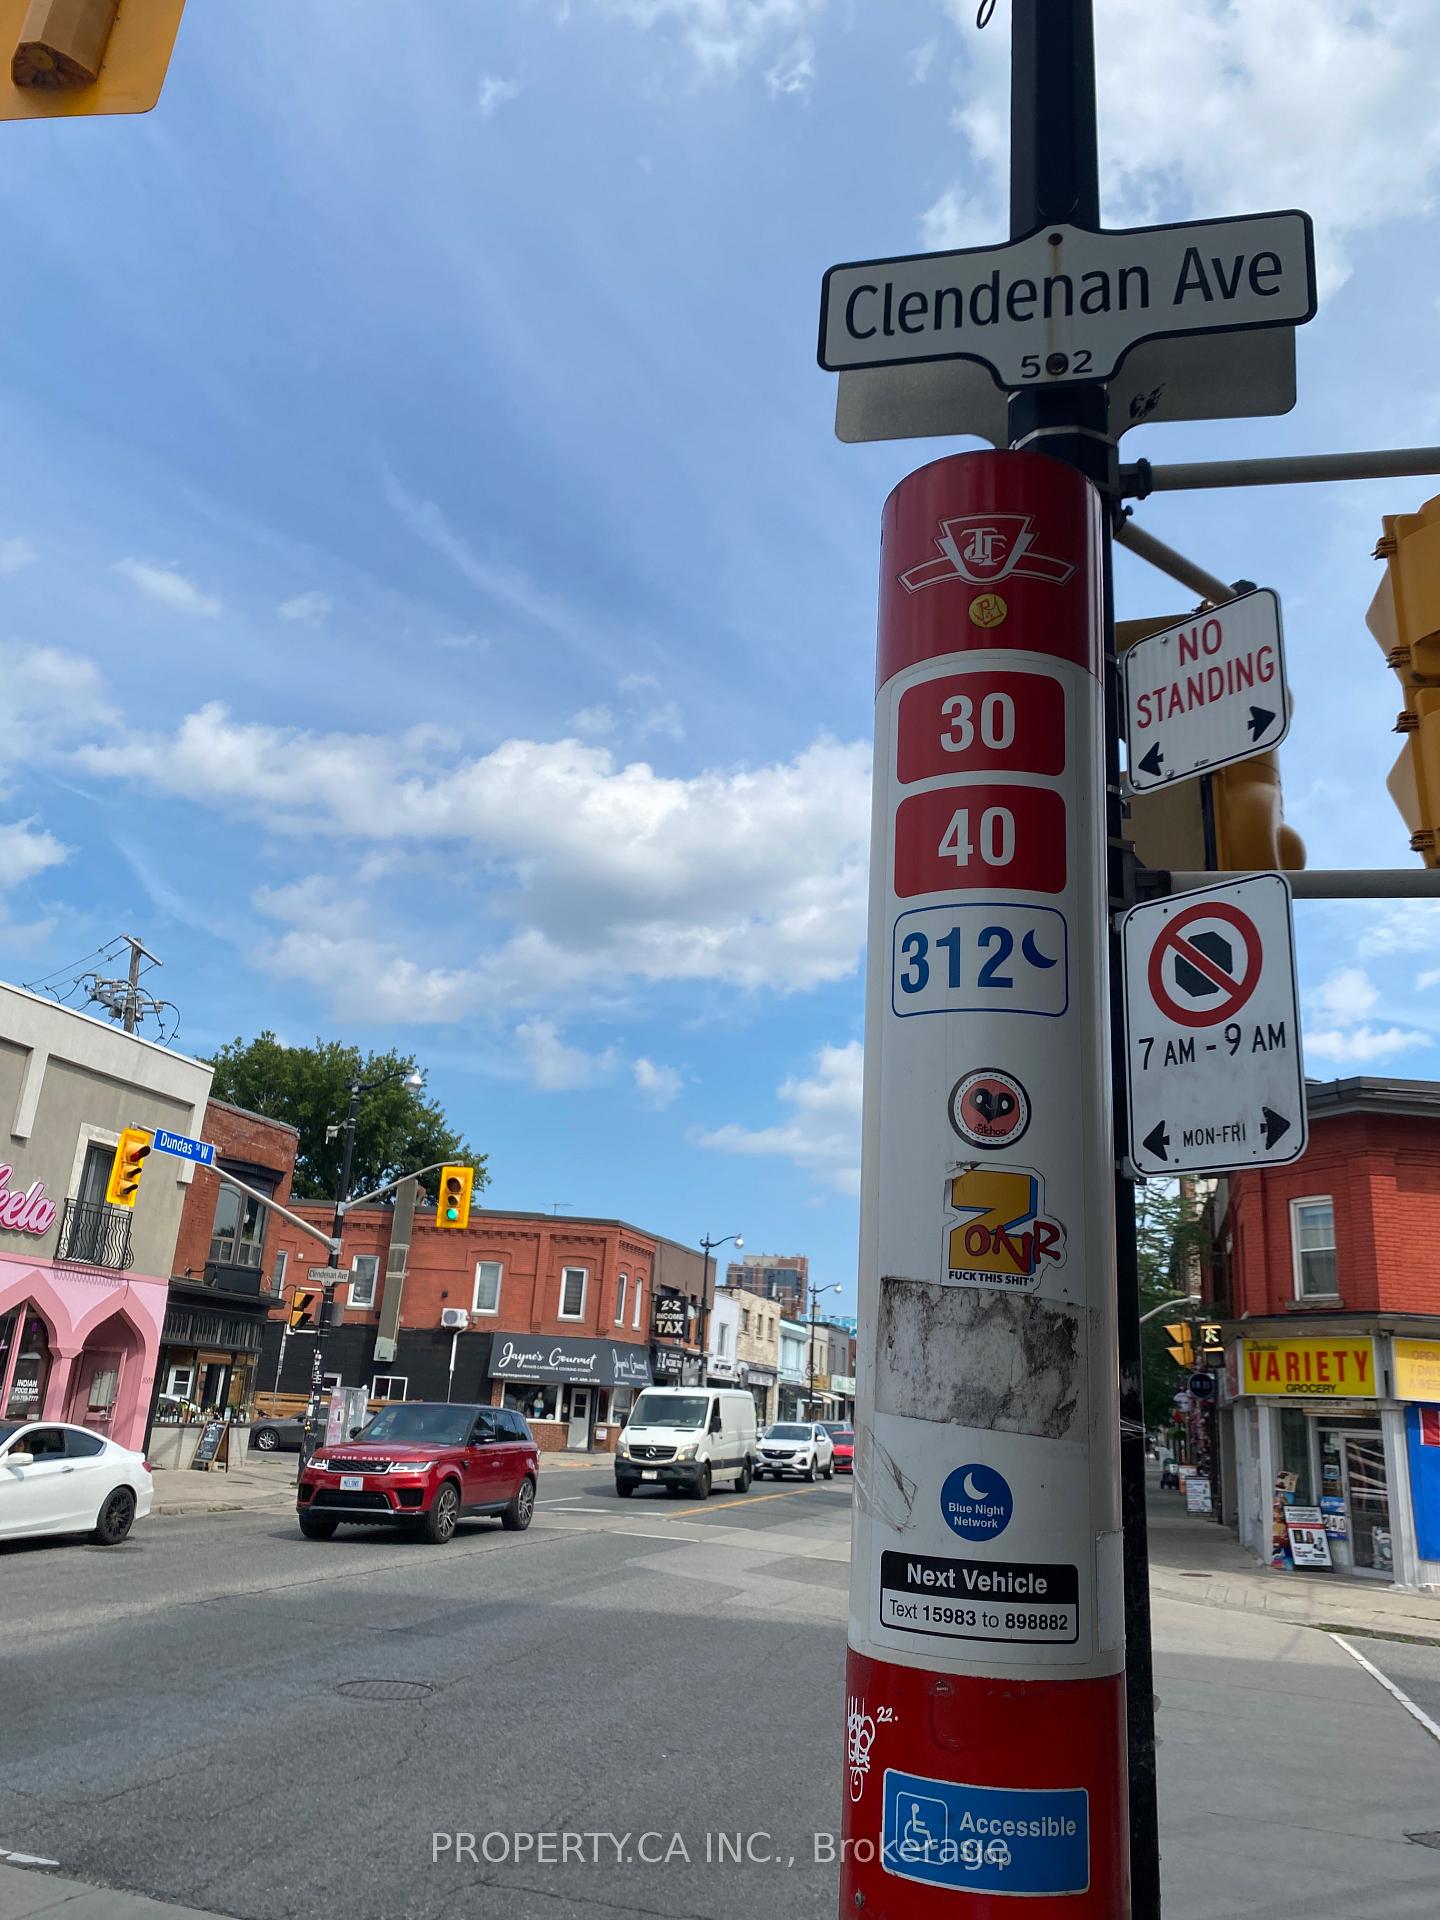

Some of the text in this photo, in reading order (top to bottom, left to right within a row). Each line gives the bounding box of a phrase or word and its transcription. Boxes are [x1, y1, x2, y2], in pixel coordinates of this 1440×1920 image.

[845, 246, 1282, 340] Clendenan Ave
[1178, 619, 1222, 666] NO
[1136, 646, 1274, 728] STANDING
[940, 692, 1015, 752] 30
[938, 806, 1015, 866] 40
[900, 926, 1014, 993] 312
[1138, 1037, 1154, 1070] 7
[1164, 1037, 1195, 1067] AM
[1224, 1023, 1241, 1056] 9
[1252, 1022, 1286, 1053] AM
[160, 1132, 193, 1155] Dundas
[200, 1145, 209, 1159] W
[1183, 1124, 1246, 1147] MON-FRI
[309, 1270, 348, 1280] Clendenan Ave
[949, 1270, 976, 1281] FUCK
[978, 1273, 1003, 1284] THIS
[656, 1321, 683, 1334] TAX
[498, 1342, 598, 1370] Jayne's Gourmet
[1248, 1351, 1368, 1382] VARIETY
[17, 1379, 38, 1387] INDIAN
[1286, 1384, 1336, 1394] GROCERY
[948, 1502, 1005, 1517] Blue Night
[954, 1516, 998, 1528] Network
[907, 1563, 1048, 1594] Next Vehicle
[889, 1599, 1068, 1631] Text 15983 to 898882
[960, 1811, 1077, 1837] Accessible
